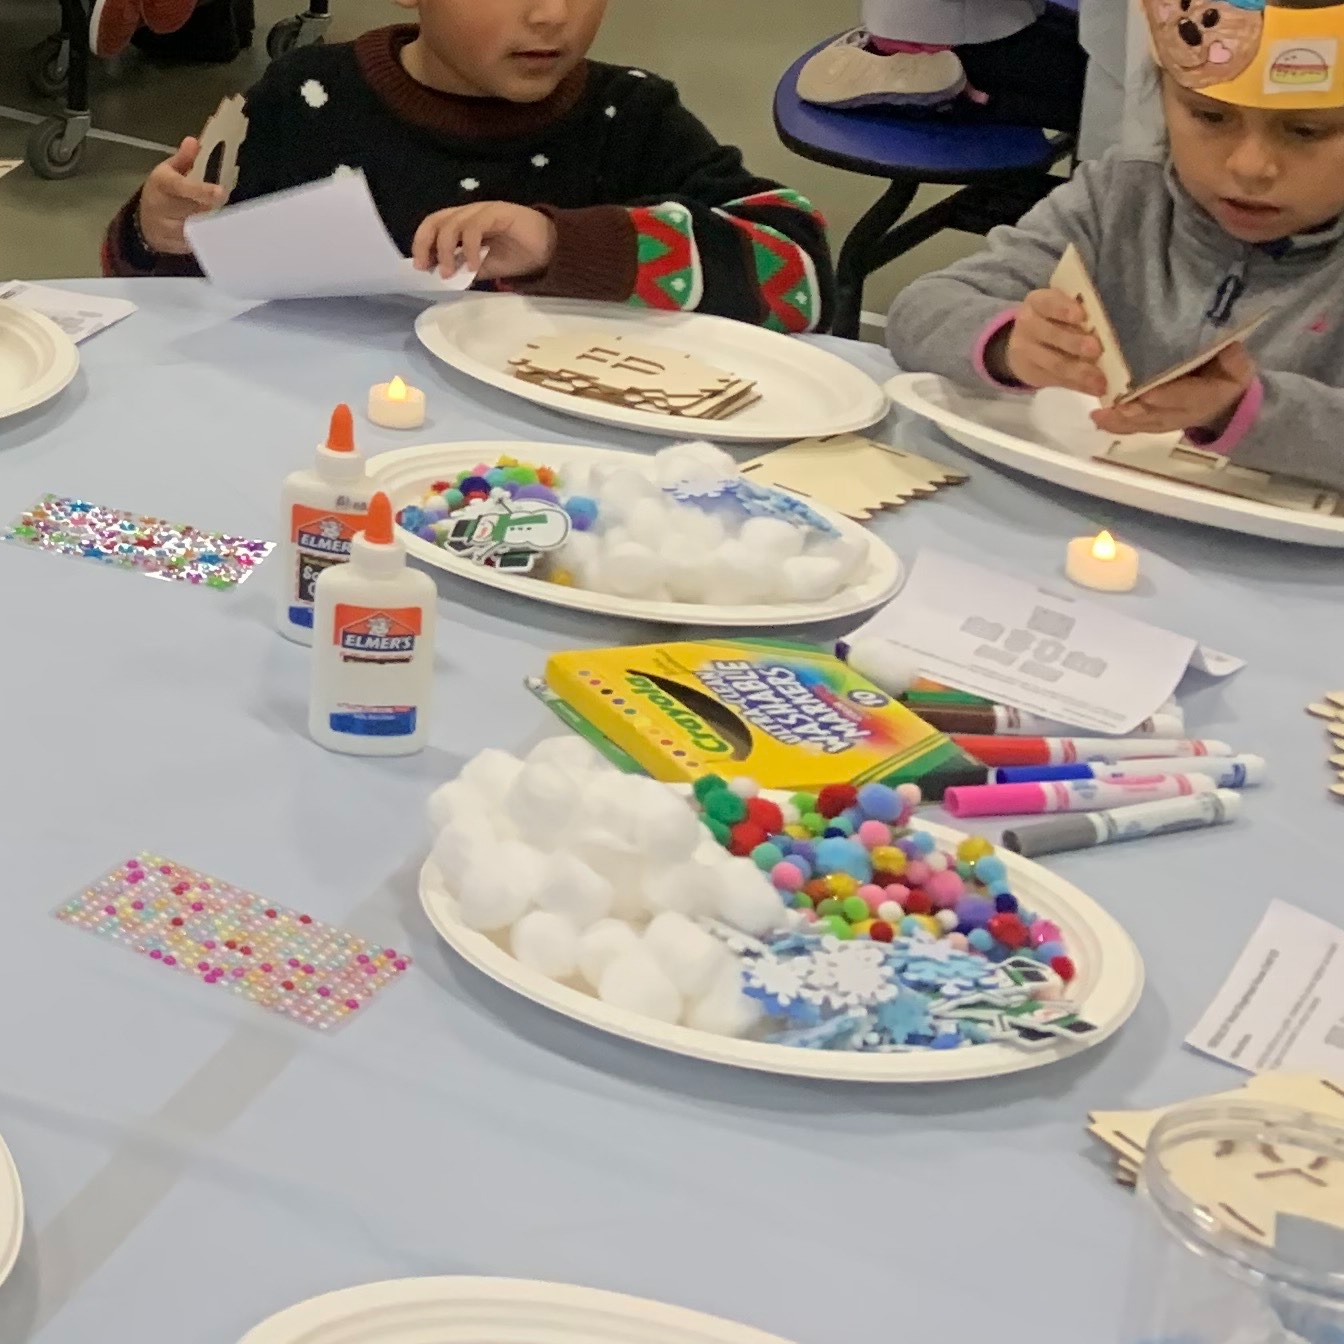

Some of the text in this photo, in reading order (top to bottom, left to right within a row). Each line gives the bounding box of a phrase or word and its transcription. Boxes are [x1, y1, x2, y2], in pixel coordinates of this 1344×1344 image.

[300, 533, 353, 553] ELMER
[344, 634, 412, 650] ELMER'S
[625, 674, 732, 753] Crayola
[715, 660, 855, 754] WASHABLE
[761, 665, 872, 739] MARKERS
[853, 691, 885, 706] 10
